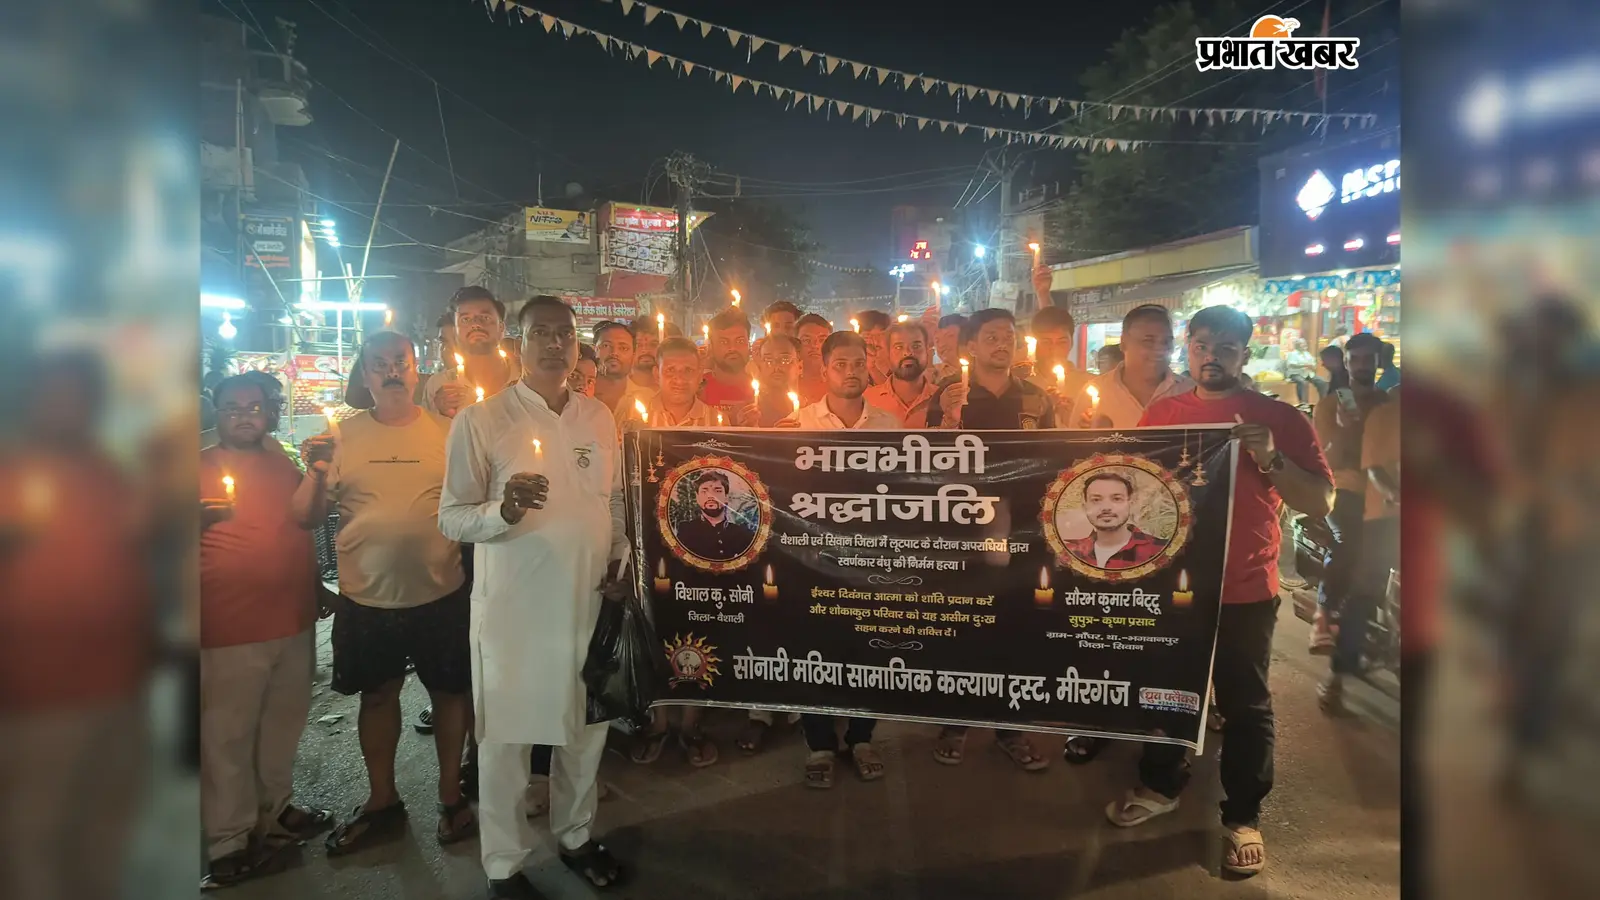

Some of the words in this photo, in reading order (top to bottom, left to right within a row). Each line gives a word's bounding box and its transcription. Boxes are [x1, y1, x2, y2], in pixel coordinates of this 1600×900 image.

[795, 434, 988, 474] भावभीनी
[789, 484, 1000, 525] श्रद्धांजलि
[780, 532, 809, 546] वैशाली
[811, 534, 823, 546] एवं
[825, 533, 853, 547] सिवान
[854, 535, 878, 549] जिला
[879, 534, 888, 549] में
[889, 536, 919, 552] लूटपाट
[921, 537, 931, 550] के
[933, 537, 959, 551] दौरान
[961, 538, 1008, 555] अपराधियों
[1009, 541, 1030, 555] द्वारा
[838, 555, 875, 569] स्वर्णकार
[893, 556, 907, 570] की
[907, 556, 934, 570] निर्मम
[936, 558, 958, 571] हत्या
[675, 581, 710, 602] विशाल
[711, 587, 727, 610] कु.
[729, 584, 754, 604] सोनी
[811, 586, 836, 599] ईश्वर
[838, 588, 872, 602] दिवंगत
[874, 591, 903, 603] आत्मा
[905, 591, 919, 604] को
[921, 591, 946, 605] शांति
[948, 595, 974, 606] प्रदान
[976, 594, 996, 607] करें
[1065, 587, 1097, 606] सौरभ
[1098, 592, 1131, 613] कुमार
[688, 611, 716, 622] जिला-
[717, 612, 745, 624] वैशाली
[810, 602, 827, 616] और
[829, 604, 871, 621] शोकाकुल
[873, 606, 905, 619] परिवार
[906, 608, 920, 622] को
[922, 612, 938, 622] यह
[940, 611, 970, 624] असीम
[973, 613, 996, 627] दुःख
[1069, 616, 1101, 628] सुपुत्र-
[1102, 617, 1127, 629] कृष्ण
[1128, 618, 1156, 628] प्रसाद
[855, 623, 878, 635] सहन
[879, 624, 902, 636] करने
[903, 625, 917, 637] की
[1079, 641, 1112, 650] जिला-
[1113, 642, 1146, 651] सिवान
[733, 646, 789, 682] सोनारी
[792, 650, 843, 686] मठिया
[847, 657, 932, 690] सामाजिक
[937, 670, 1005, 698] कल्याण
[1008, 674, 1051, 711] ट्रस्ट,
[1057, 666, 1131, 707] मीरगंज
